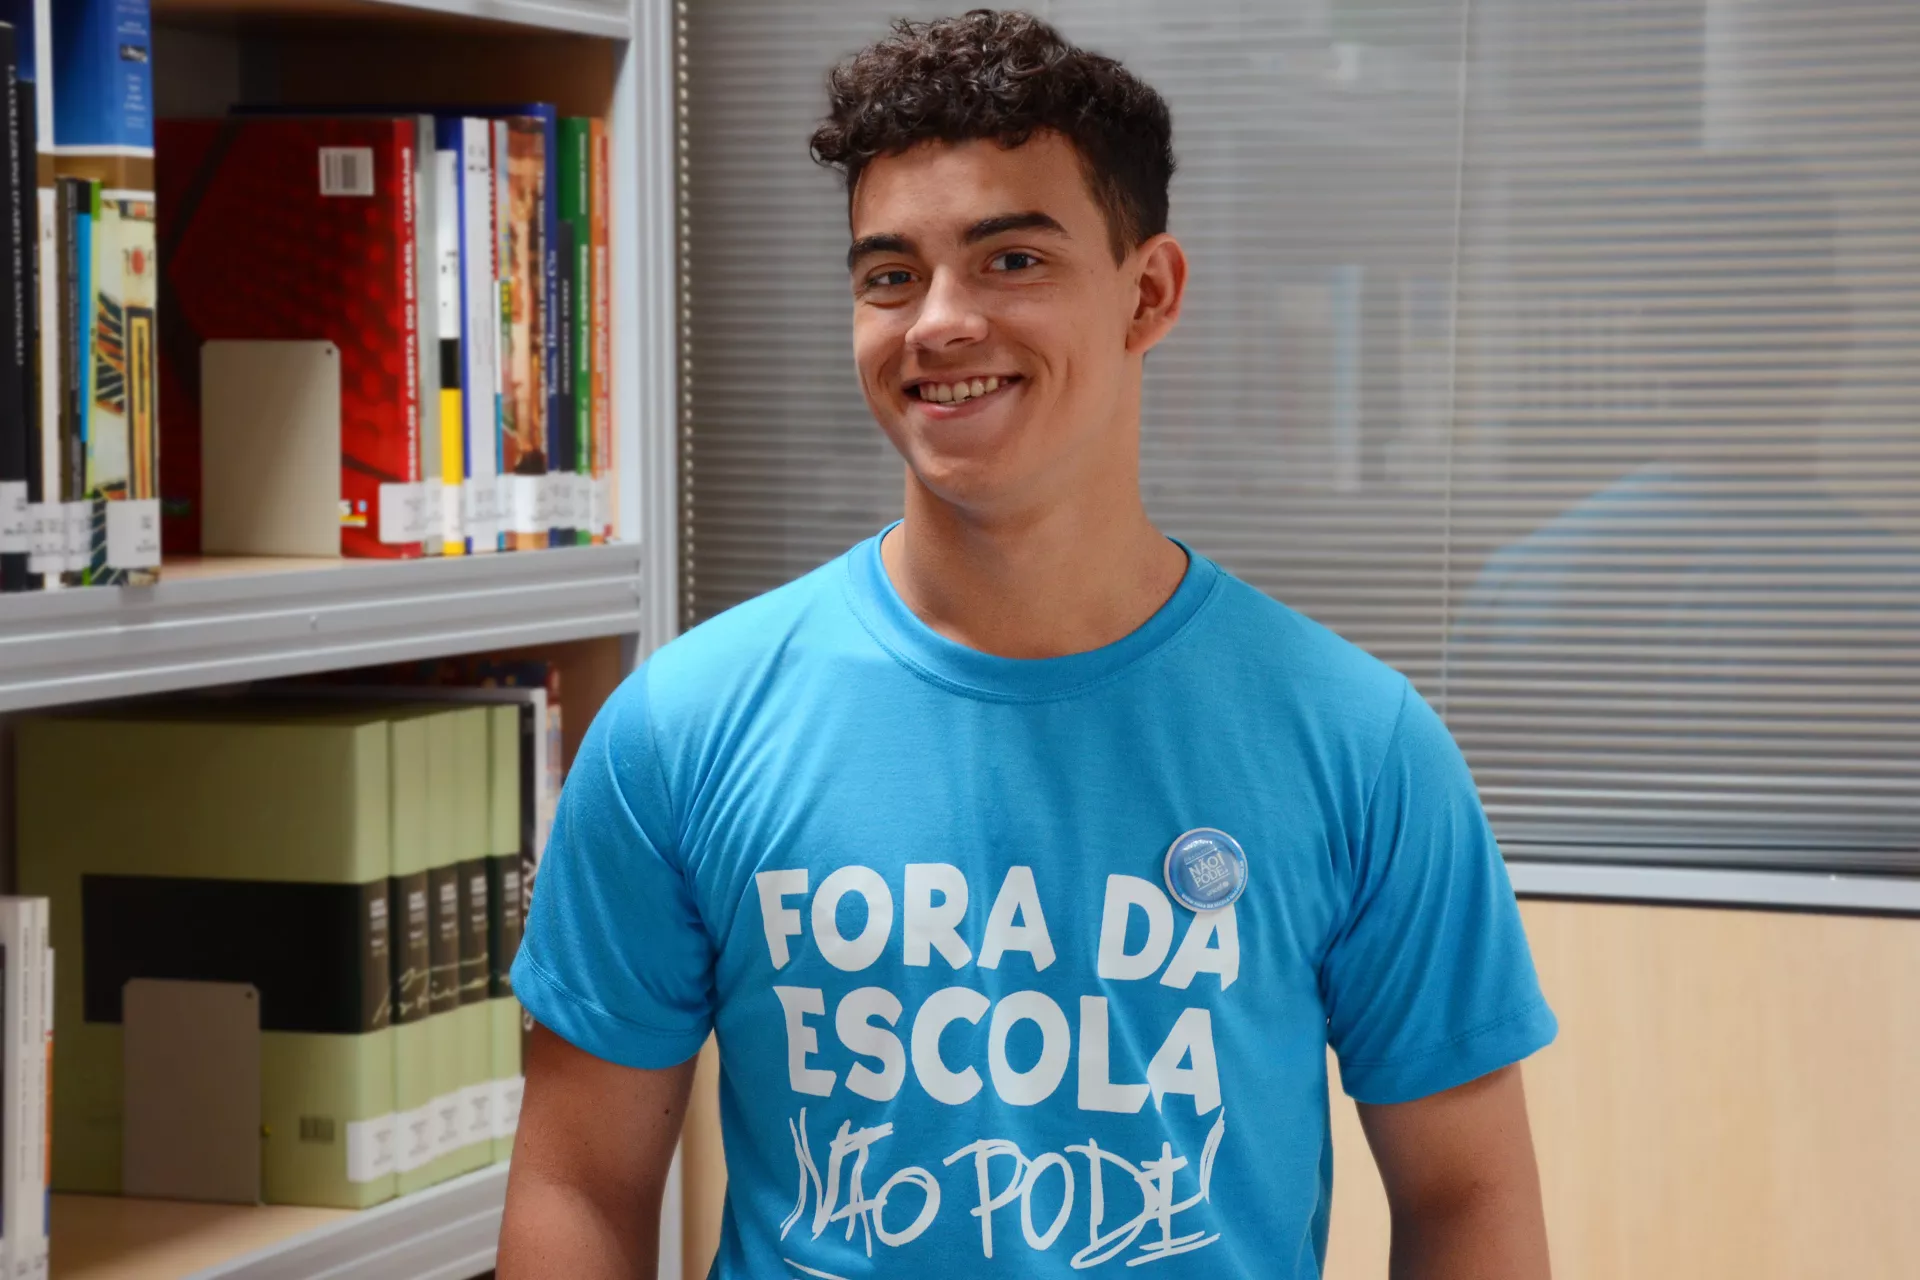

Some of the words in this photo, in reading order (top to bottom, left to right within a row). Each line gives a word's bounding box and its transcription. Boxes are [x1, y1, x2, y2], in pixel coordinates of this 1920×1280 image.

[403, 237, 414, 299] BRASIL
[404, 303, 415, 330] DO
[405, 334, 416, 400] ABERTA
[755, 862, 1057, 971] FORA
[1097, 873, 1240, 992] DA
[773, 985, 1222, 1115] ESCOLA
[780, 1107, 941, 1258] NÃO
